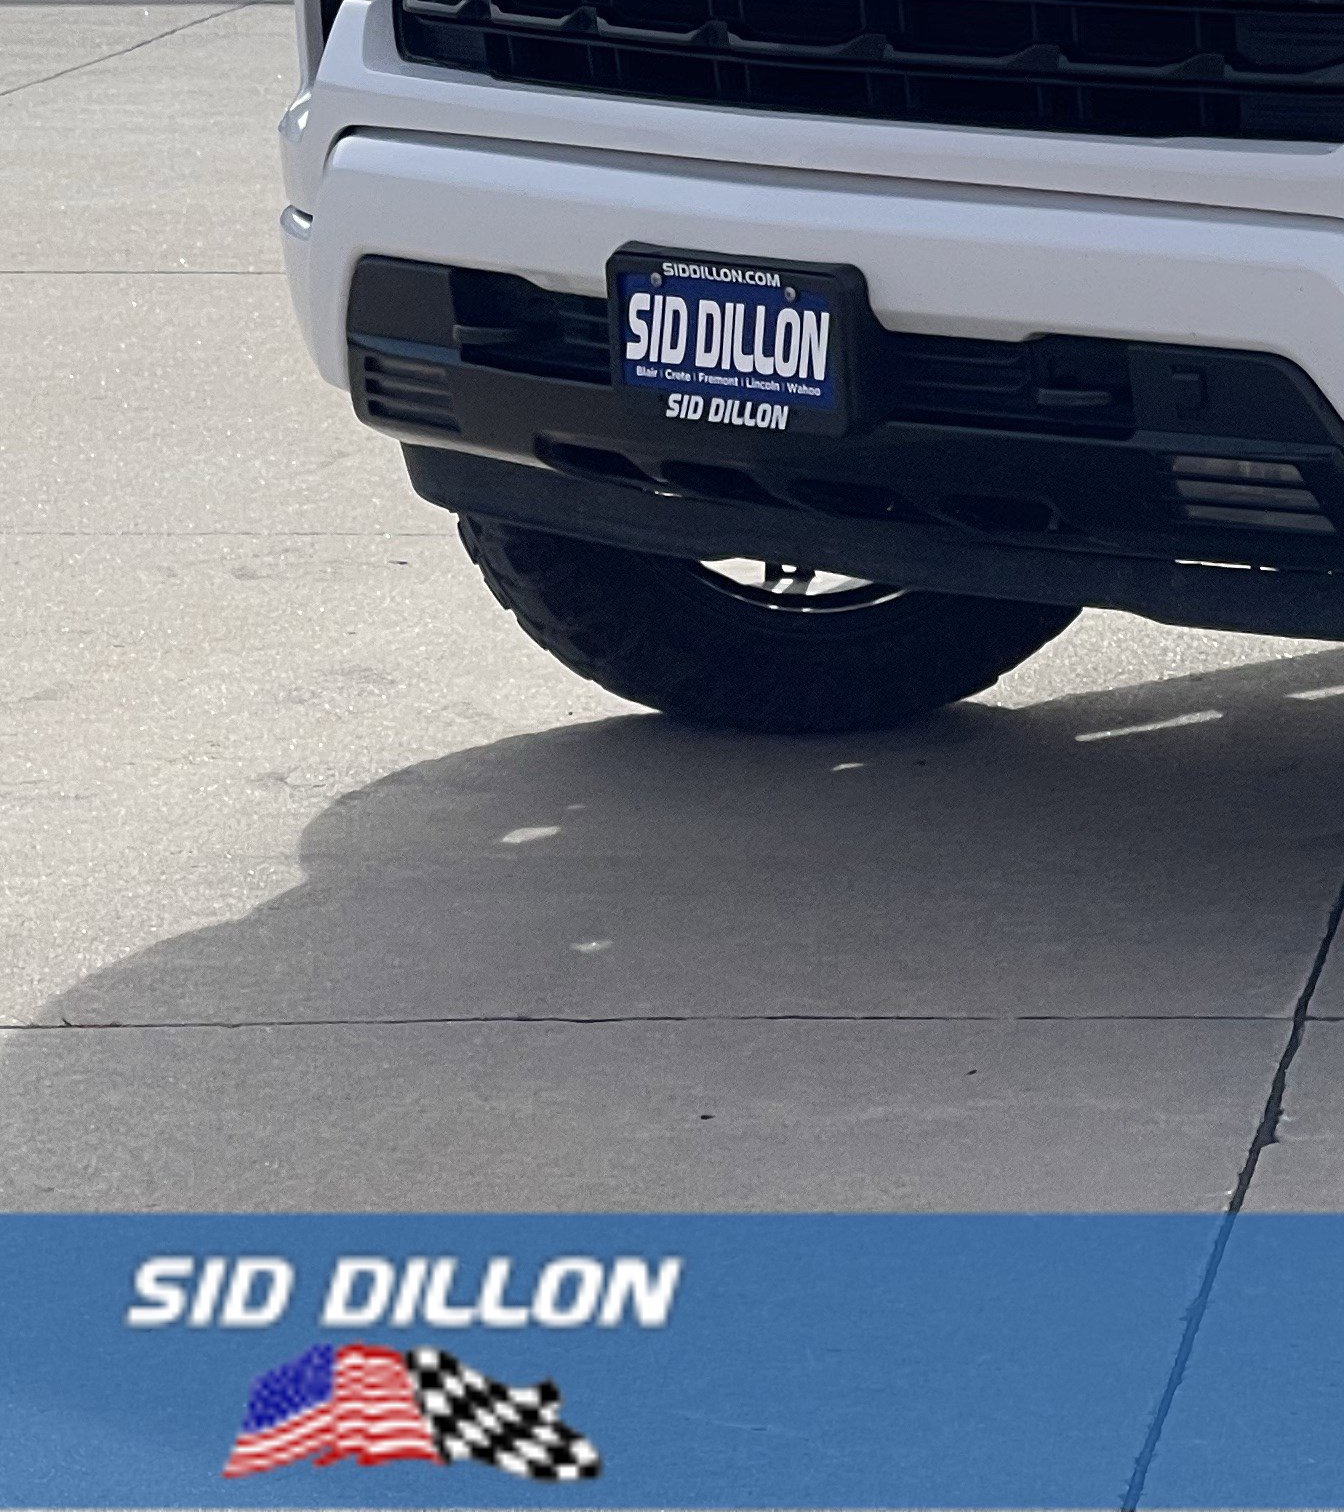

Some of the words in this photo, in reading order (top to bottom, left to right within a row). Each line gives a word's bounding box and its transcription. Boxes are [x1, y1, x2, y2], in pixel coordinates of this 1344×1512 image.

[662, 262, 781, 288] SIDDILLON.COM
[626, 292, 688, 365] SID
[695, 299, 830, 381] DILLON
[636, 365, 658, 378] Blair
[664, 368, 692, 382] Crete
[698, 372, 739, 388] Fremont
[745, 377, 781, 392] Lincoln
[786, 382, 822, 397] Wahoo
[665, 392, 704, 420] SID
[708, 397, 789, 430] DILLON
